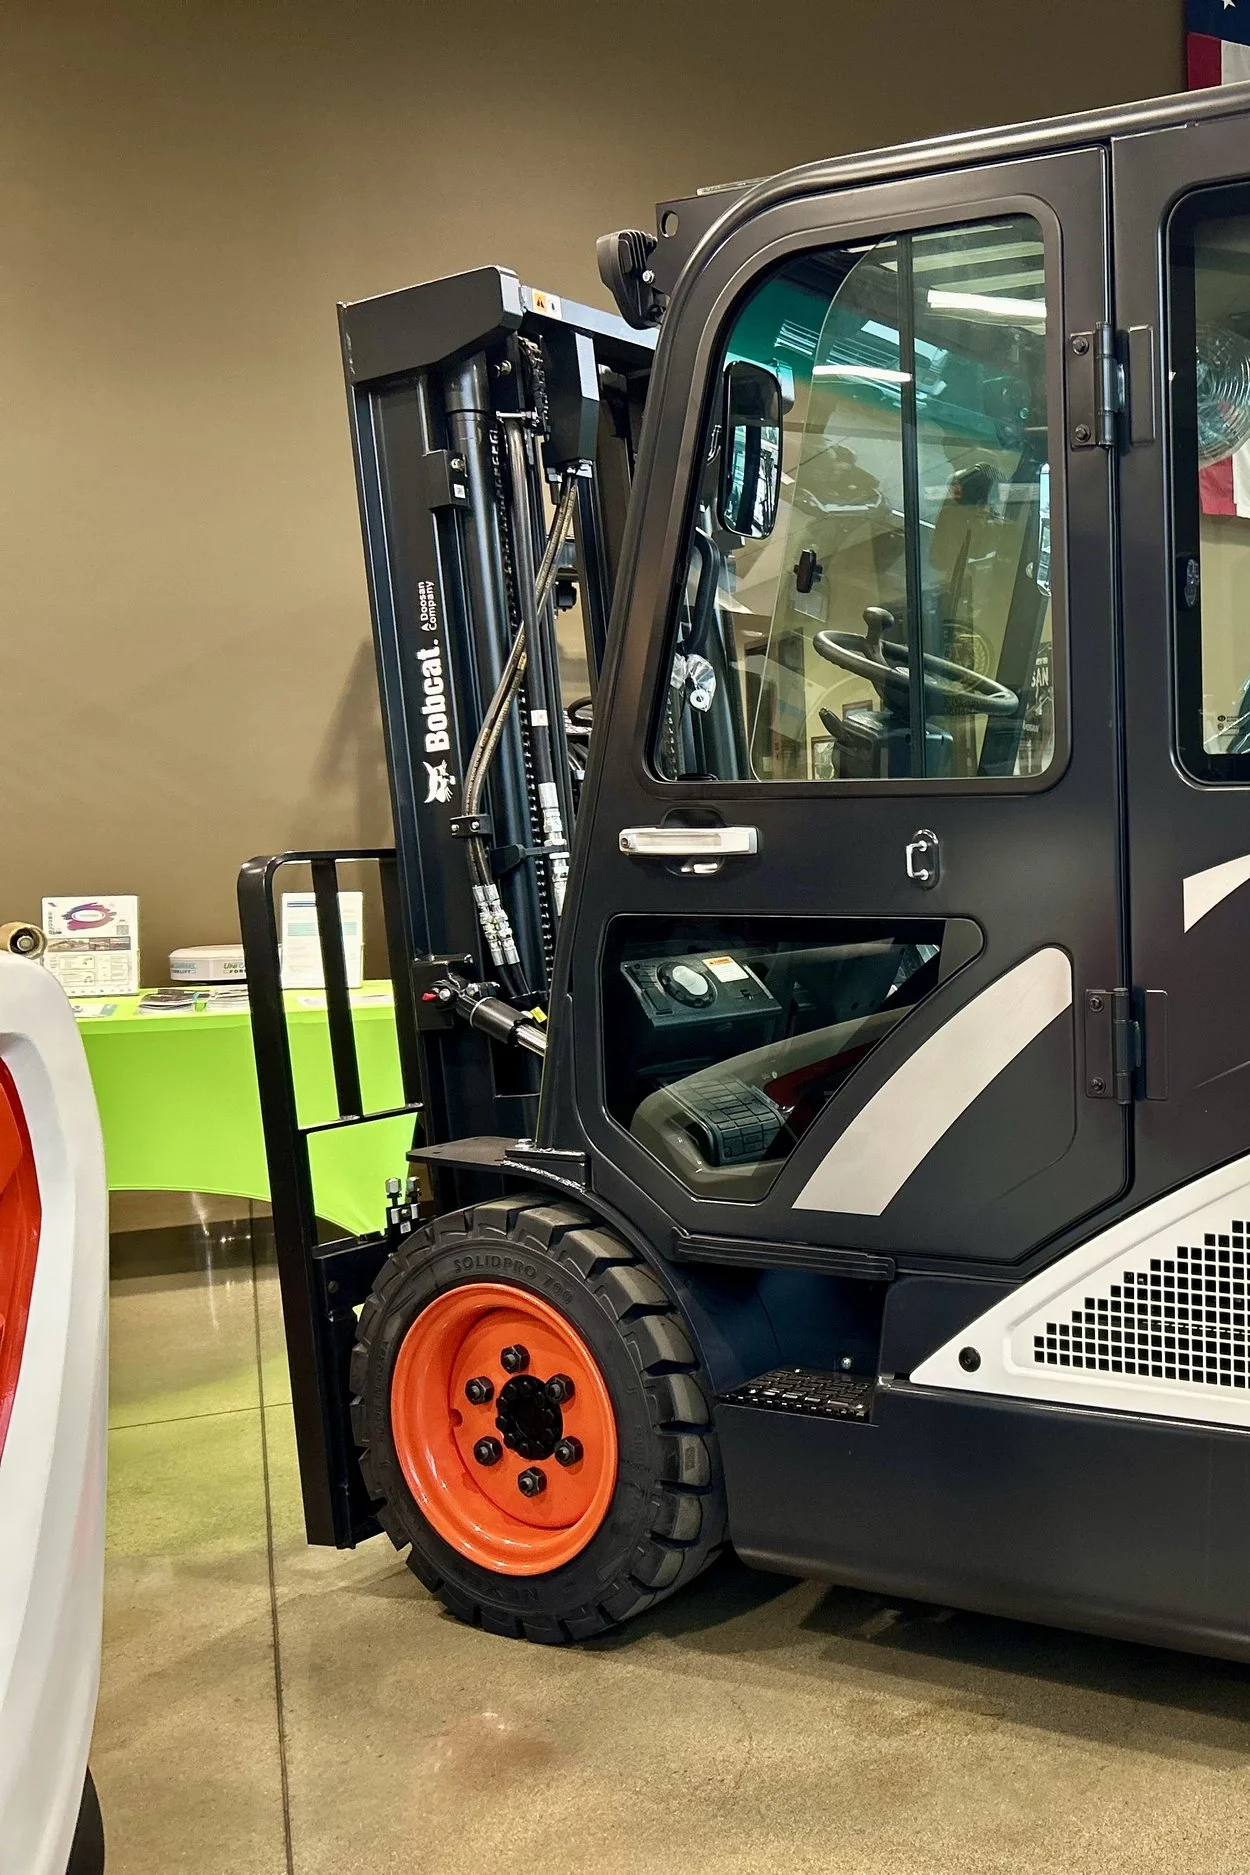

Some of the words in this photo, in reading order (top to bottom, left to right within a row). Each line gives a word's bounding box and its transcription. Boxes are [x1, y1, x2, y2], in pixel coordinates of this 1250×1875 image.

[418, 581, 430, 621] Doosan
[425, 580, 438, 631] Company
[421, 623, 430, 632] A
[453, 1254, 538, 1280] SOLIDPRO
